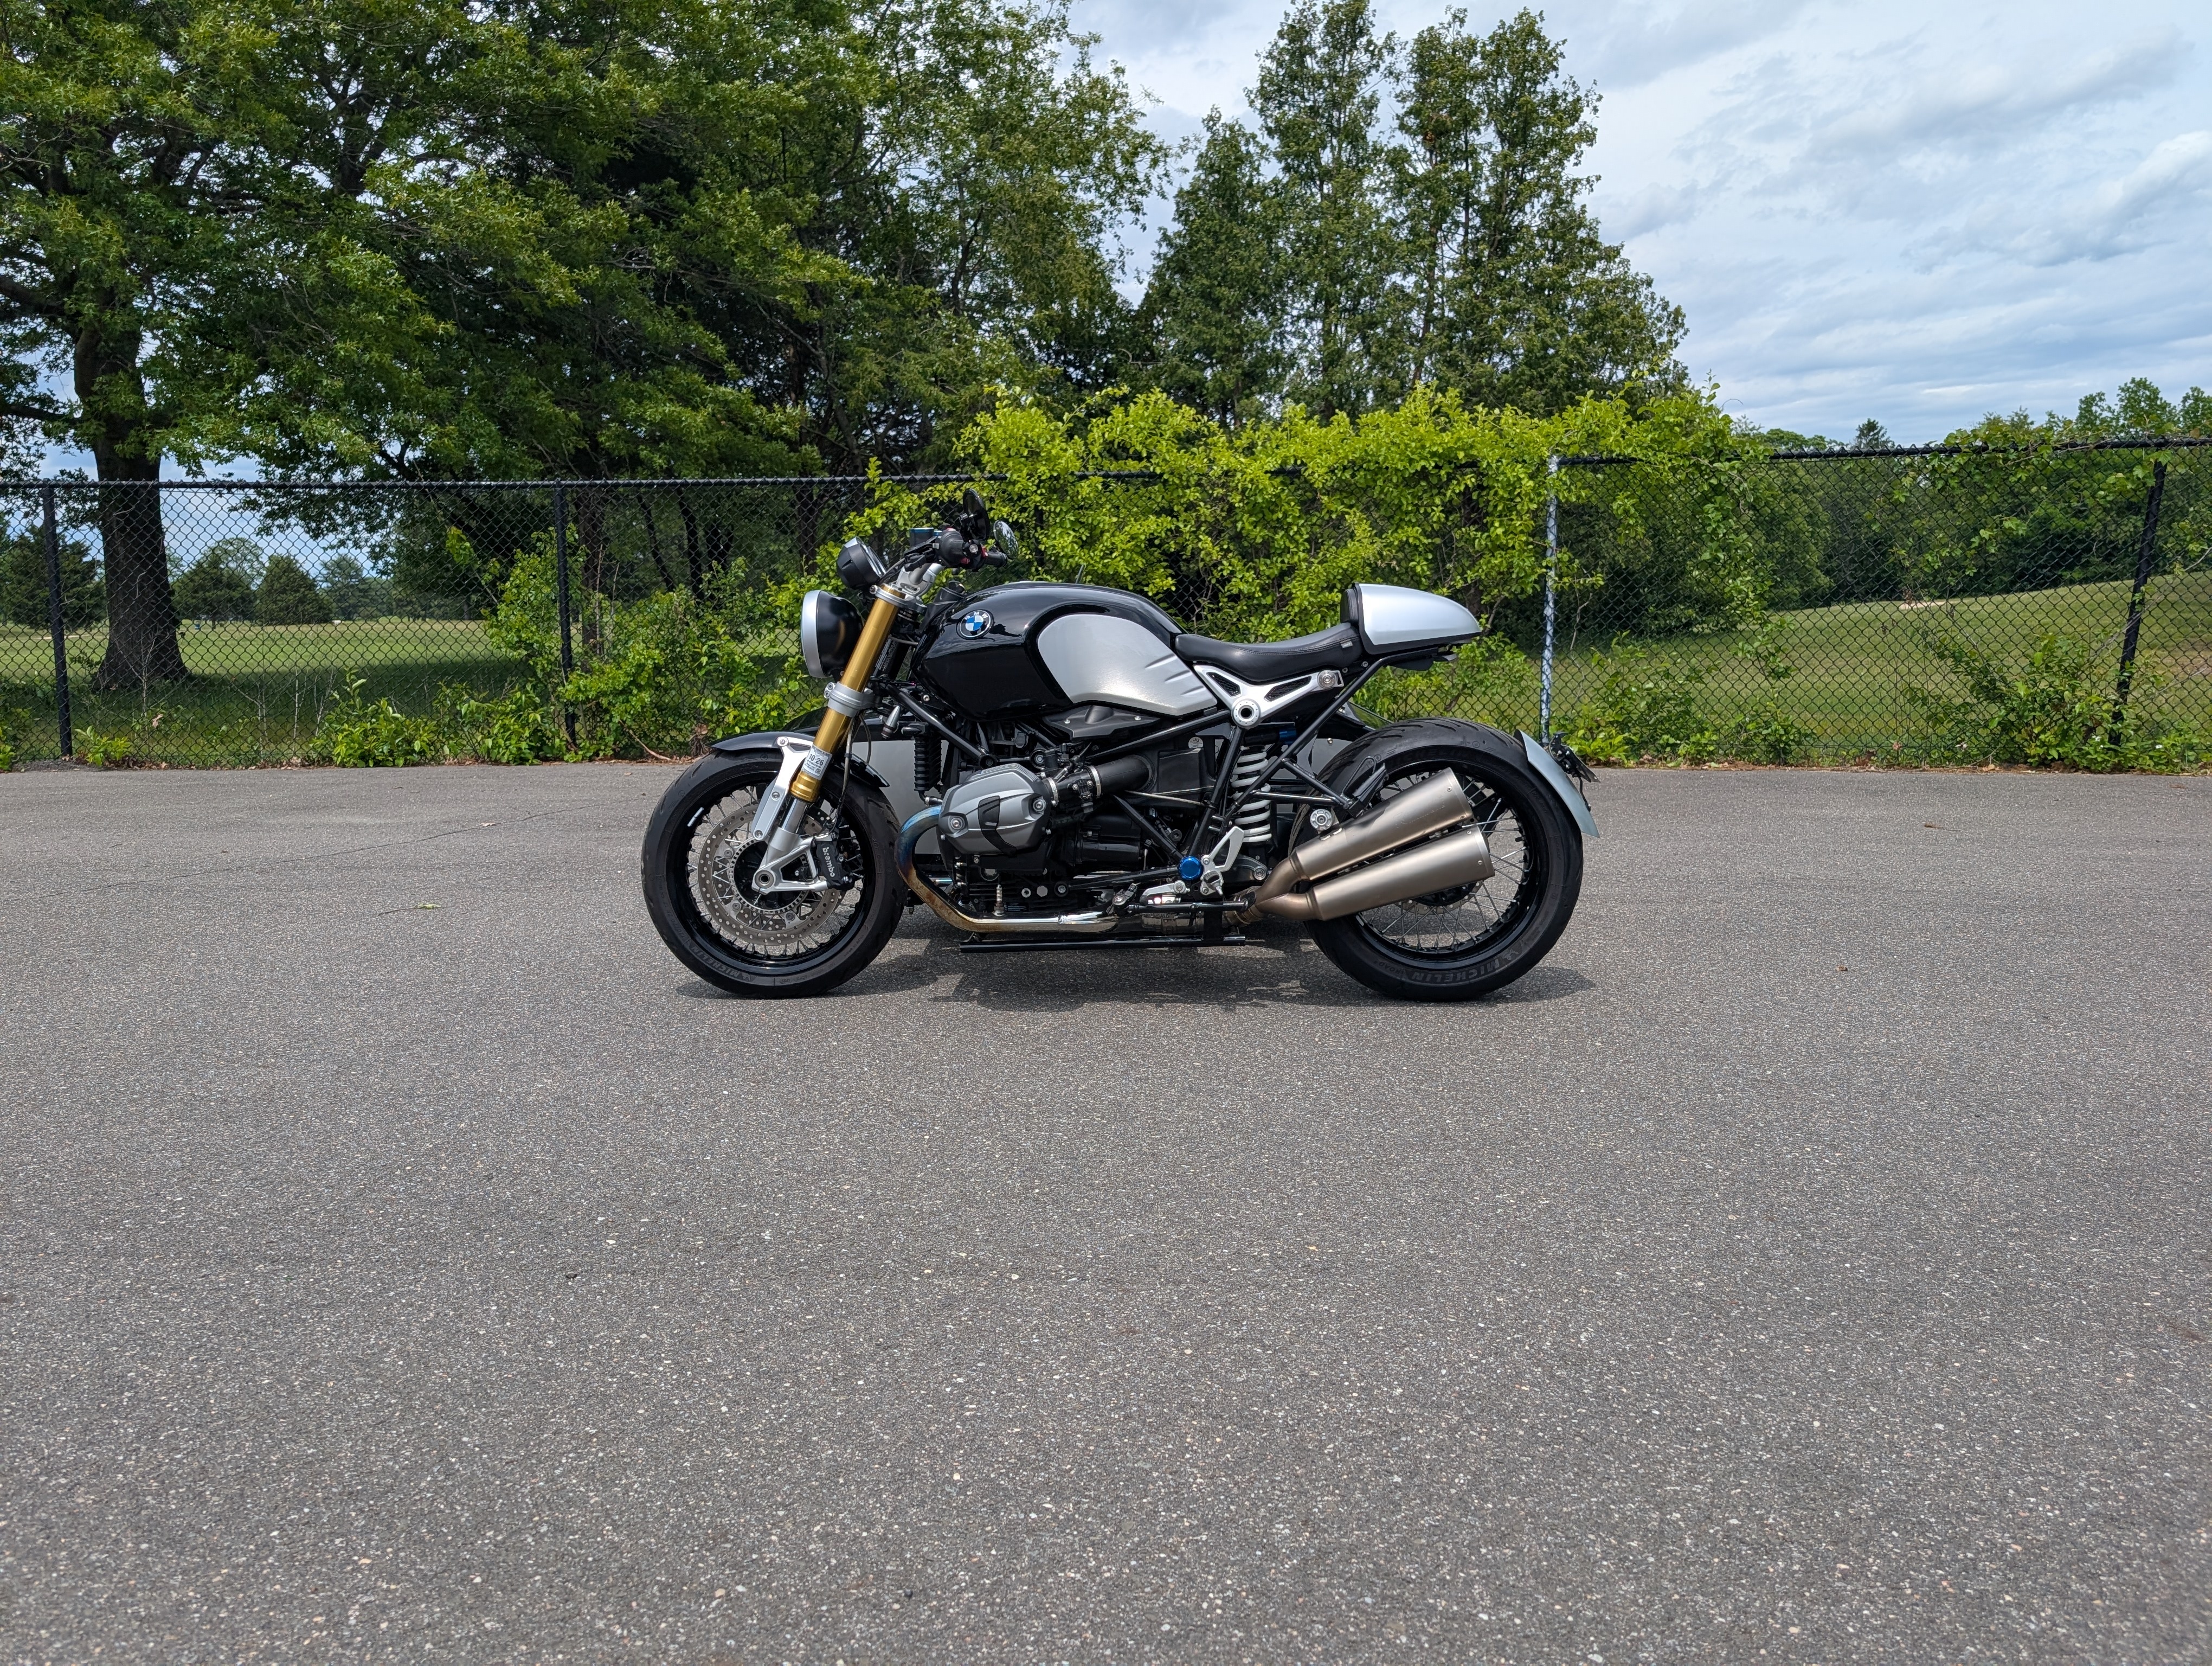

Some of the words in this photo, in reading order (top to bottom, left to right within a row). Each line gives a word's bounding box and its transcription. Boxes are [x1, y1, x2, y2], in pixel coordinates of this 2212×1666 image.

[964, 611, 988, 620] BMW
[809, 753, 824, 766] 10-26
[822, 847, 835, 877] brembo
[691, 946, 742, 977] MICHELIN
[1412, 958, 1501, 982] MICHELIN
